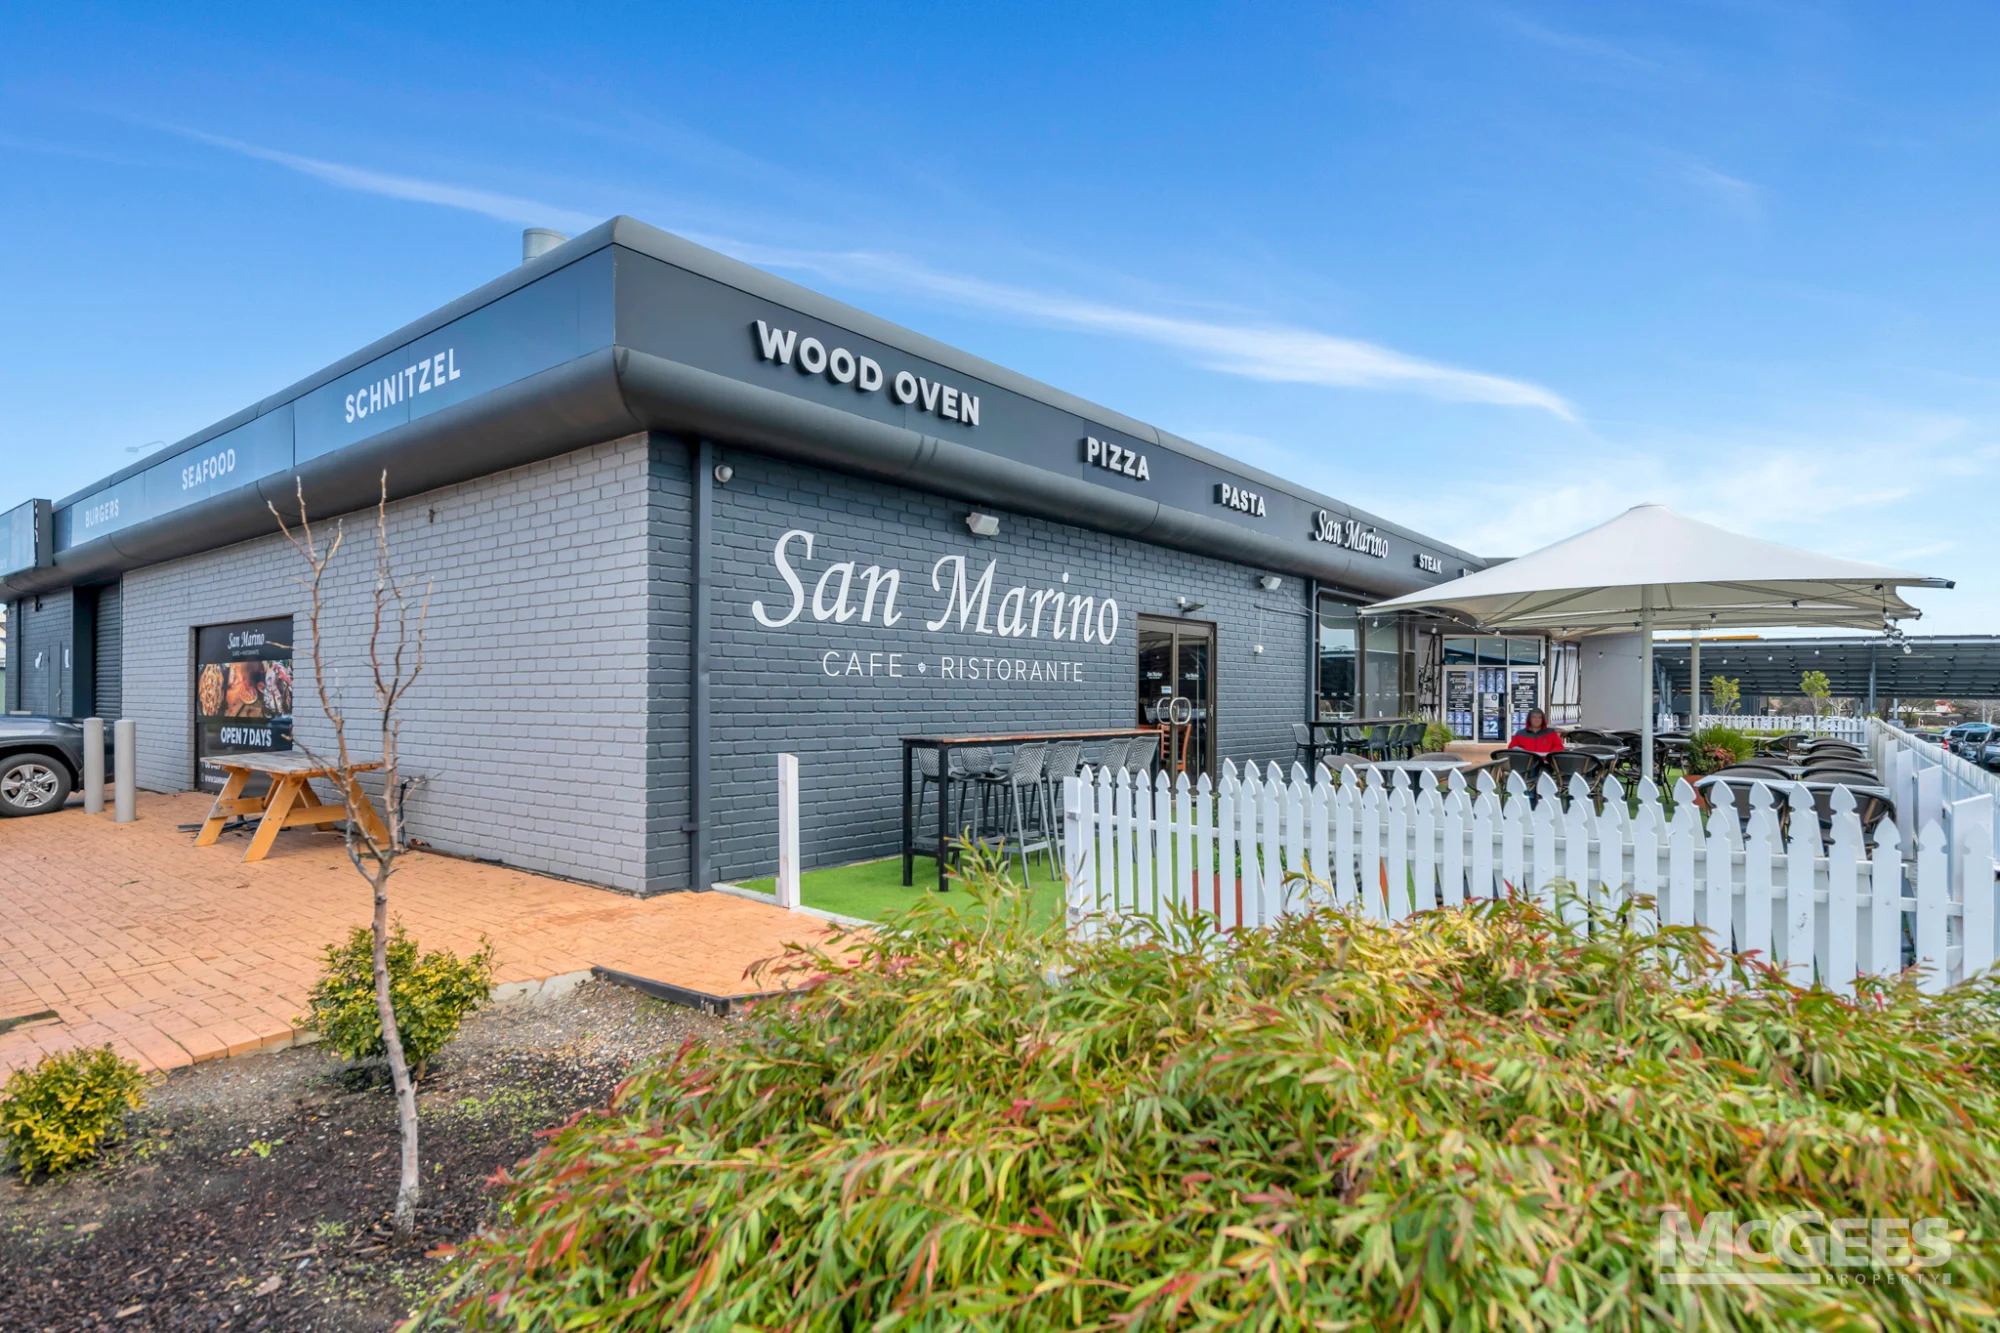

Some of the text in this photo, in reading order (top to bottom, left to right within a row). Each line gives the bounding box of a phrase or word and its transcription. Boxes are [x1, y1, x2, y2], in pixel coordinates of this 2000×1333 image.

[345, 348, 461, 424] SCHNITZEL
[756, 319, 980, 426] WOOD OVEN
[182, 448, 236, 490] SEAFOOD
[1087, 436, 1150, 481] PIZZA
[85, 498, 120, 528] BURGERS
[1222, 482, 1267, 517] PASTA
[1315, 510, 1389, 558] San Marino
[1419, 553, 1442, 574] STEAK
[752, 529, 1119, 645] San Marino
[227, 629, 265, 649] San Marino
[822, 650, 1083, 683] CAFE RISTORANTE
[220, 726, 272, 747] OPEN 7 DAYS
[1489, 721, 1498, 732] 2
